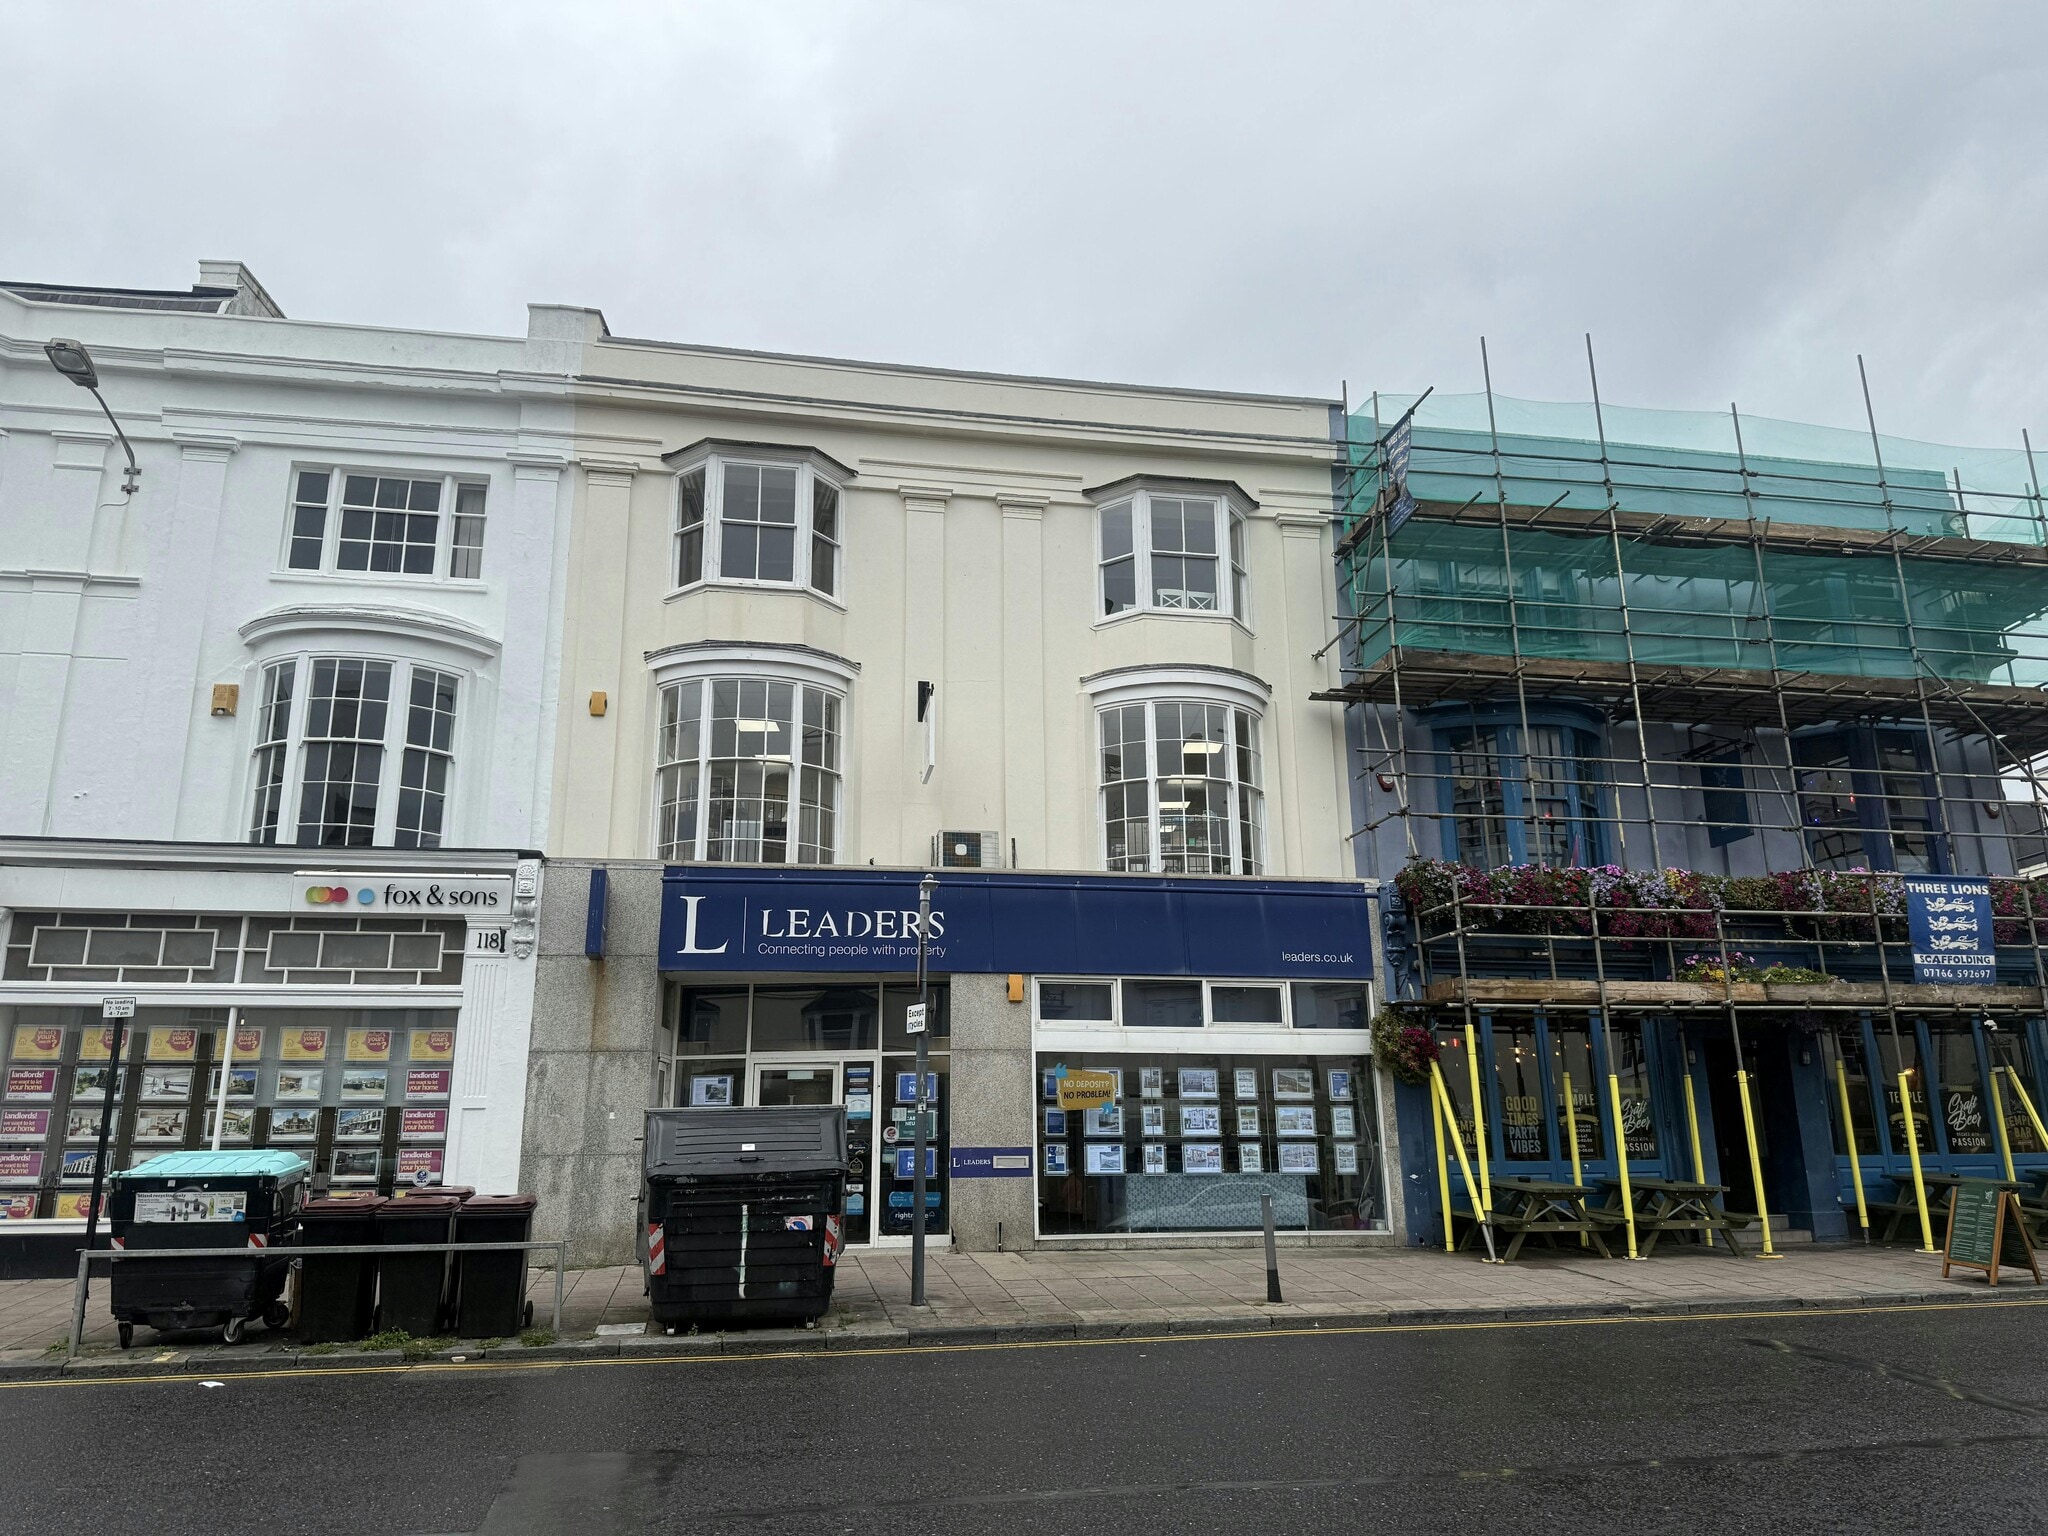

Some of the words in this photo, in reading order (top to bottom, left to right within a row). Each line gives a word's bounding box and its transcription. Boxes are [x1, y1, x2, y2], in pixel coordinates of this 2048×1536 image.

[384, 884, 421, 906] fox
[426, 884, 444, 906] &
[448, 891, 498, 906] sons
[1906, 882, 1948, 894] THREE
[1951, 884, 1990, 895] LIONS
[676, 896, 730, 954] L
[760, 909, 945, 939] LEADERS
[476, 932, 500, 949] 118
[758, 943, 825, 958] Connecting
[829, 944, 868, 957] people
[872, 944, 896, 956] with
[1282, 952, 1354, 963] leaders.co.uk
[1920, 955, 1991, 964] SCAFFOLDING
[1957, 970, 1991, 978] 592697
[1064, 1091, 1074, 1099] NO
[1076, 1090, 1111, 1098] PROBLEM!
[1505, 1096, 1537, 1112] GOOD
[1948, 1093, 1978, 1114] Craft
[1506, 1112, 1539, 1126] TIMES
[1623, 1114, 1650, 1134] Beer
[1947, 1110, 1982, 1130] Beer
[1509, 1126, 1539, 1139] PARTY
[2014, 1127, 2032, 1138] BAR
[1510, 1140, 1541, 1153] VIBES
[1626, 1142, 1655, 1152] ASSION
[1952, 1137, 1986, 1146] PASSION
[953, 1158, 960, 1168] L
